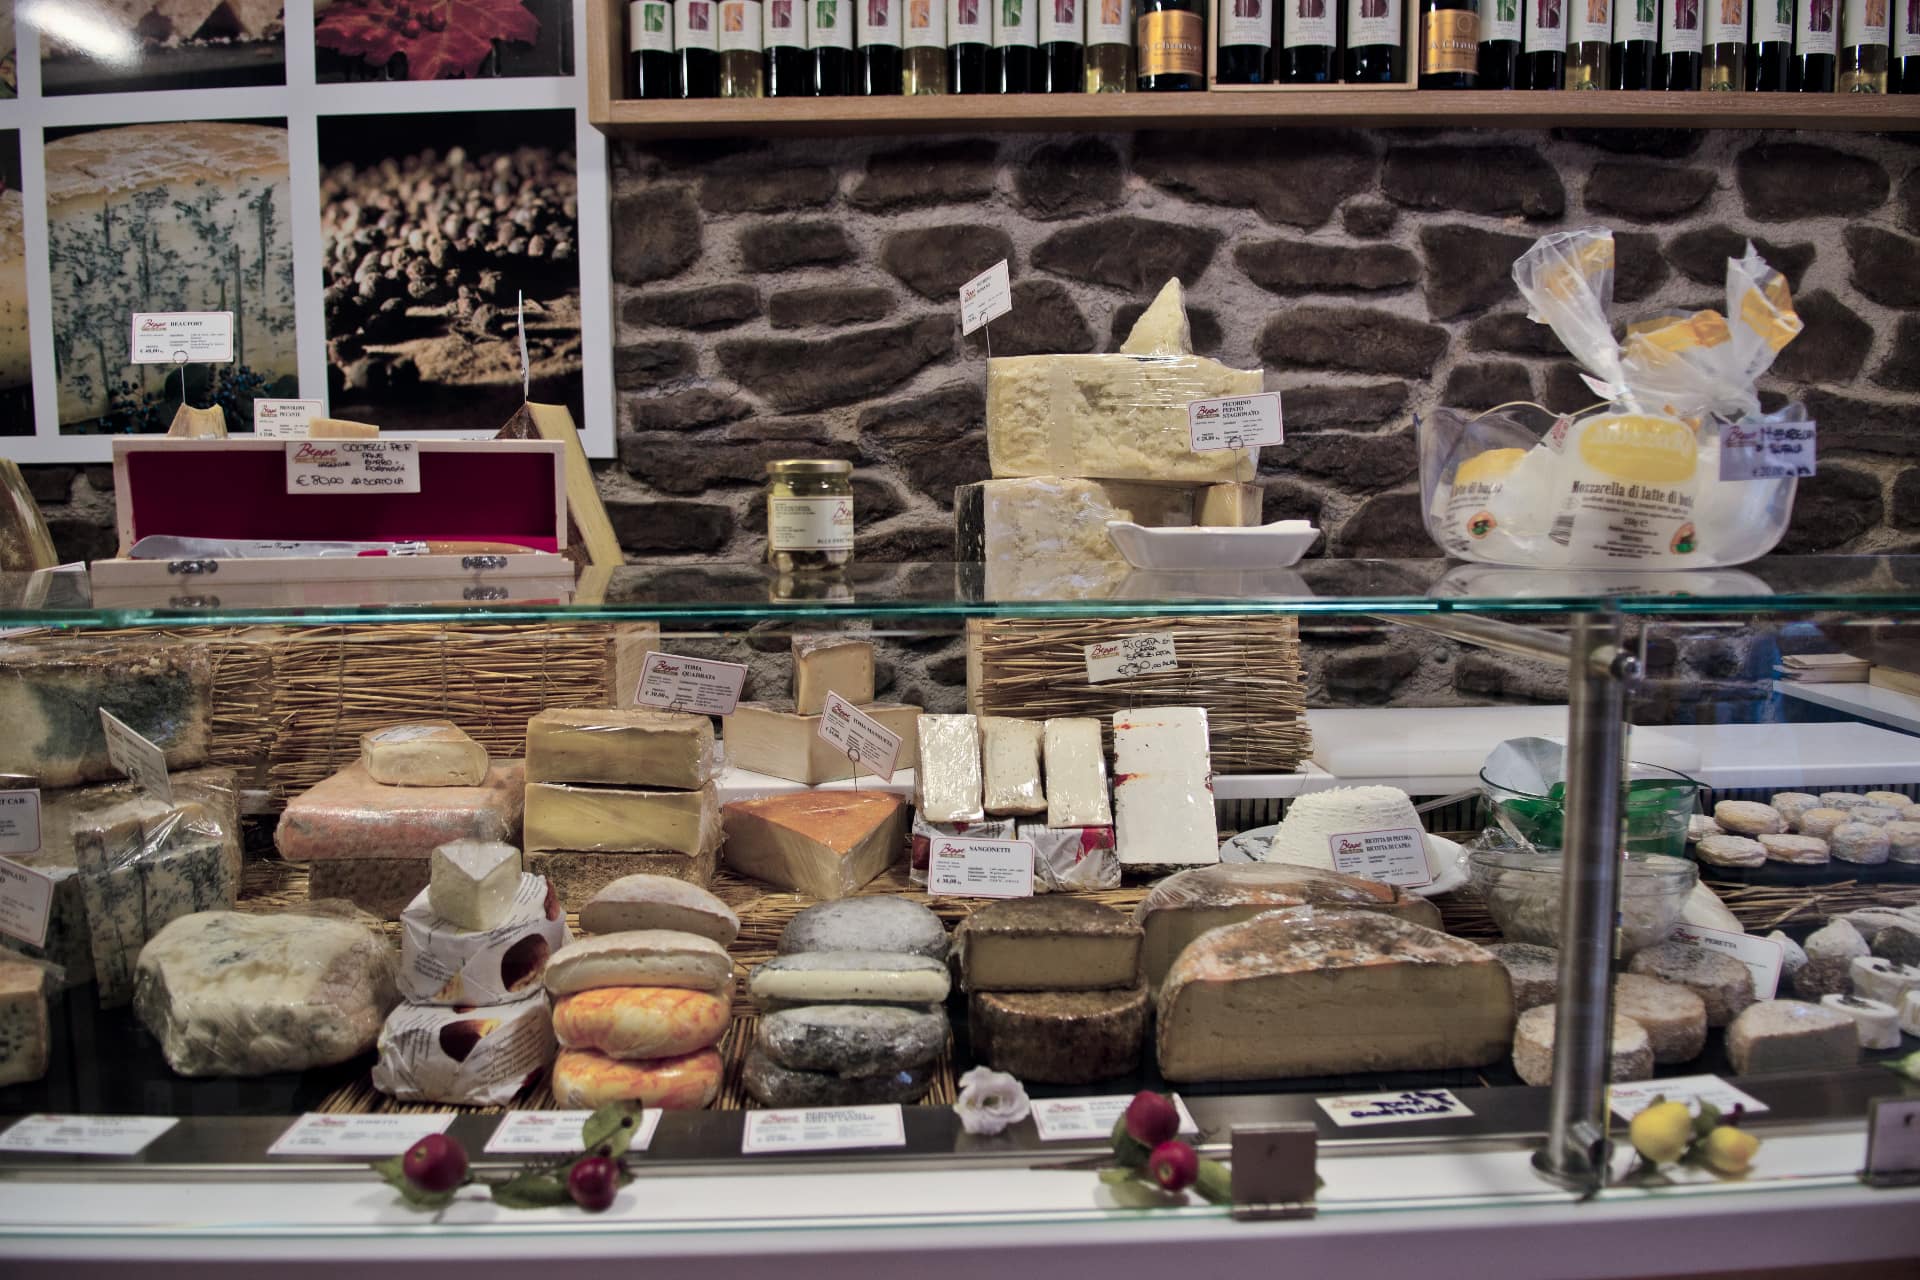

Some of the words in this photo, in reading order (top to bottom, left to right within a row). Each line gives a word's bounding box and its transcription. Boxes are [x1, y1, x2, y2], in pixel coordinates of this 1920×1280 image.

[1222, 400, 1252, 408] PECORINO
[1222, 411, 1260, 419] STAGIONATO
[293, 442, 338, 460] Beppe
[1571, 481, 1626, 498] Mozzarella
[1628, 484, 1640, 498] di
[1641, 486, 1665, 502] latte
[684, 664, 702, 672] TOMA
[682, 671, 716, 682] QUADRATA
[1364, 836, 1387, 845] RICOTTA
[1393, 834, 1413, 842] PECORA
[938, 843, 966, 856] Beppe
[969, 846, 1011, 854] SANGONETTI
[1339, 839, 1363, 852] Beppe
[1366, 844, 1388, 853] RICOTTA
[1394, 842, 1412, 850] CAPRA
